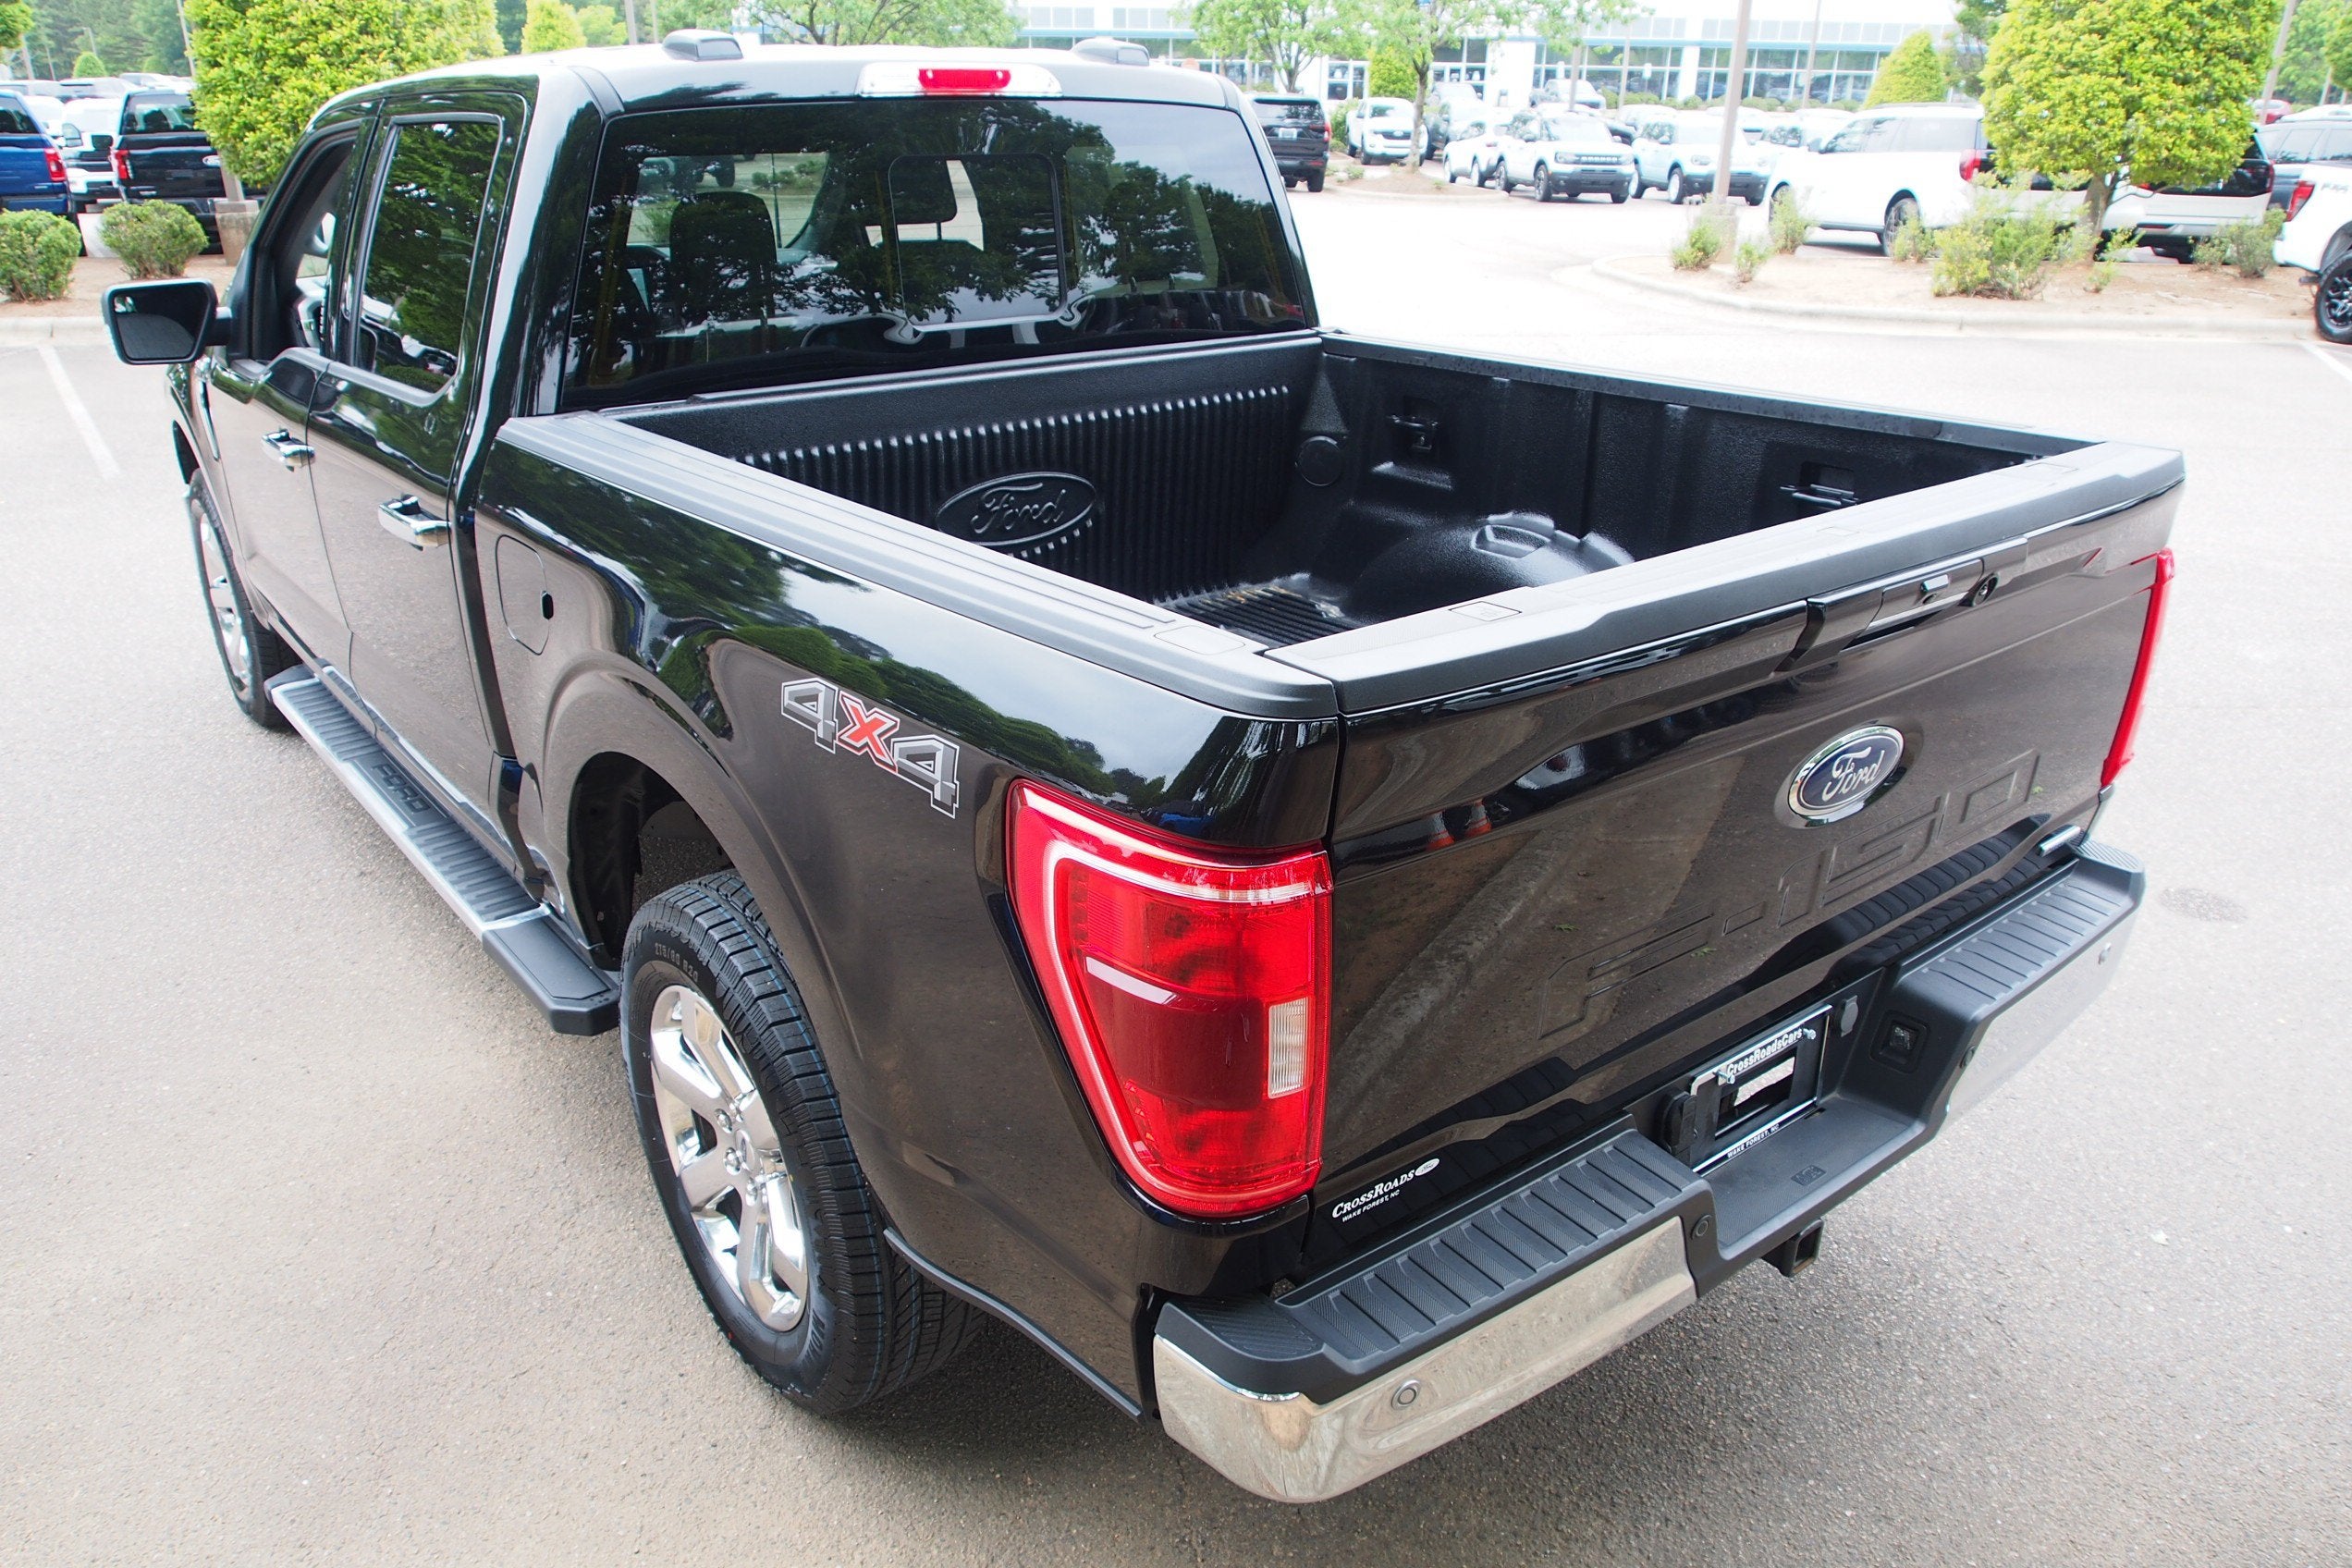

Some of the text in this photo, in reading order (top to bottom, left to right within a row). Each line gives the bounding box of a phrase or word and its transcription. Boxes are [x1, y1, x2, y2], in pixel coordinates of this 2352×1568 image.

[971, 482, 1067, 534] Ford
[372, 763, 431, 814] FORD
[1821, 745, 1886, 802] Ford
[1727, 1027, 1803, 1076] CrossRoadsCars
[1727, 1144, 1746, 1158] WAKE
[1770, 1123, 1780, 1133] NC
[1341, 1208, 1362, 1223] WAKE
[1390, 1189, 1401, 1199] NC
